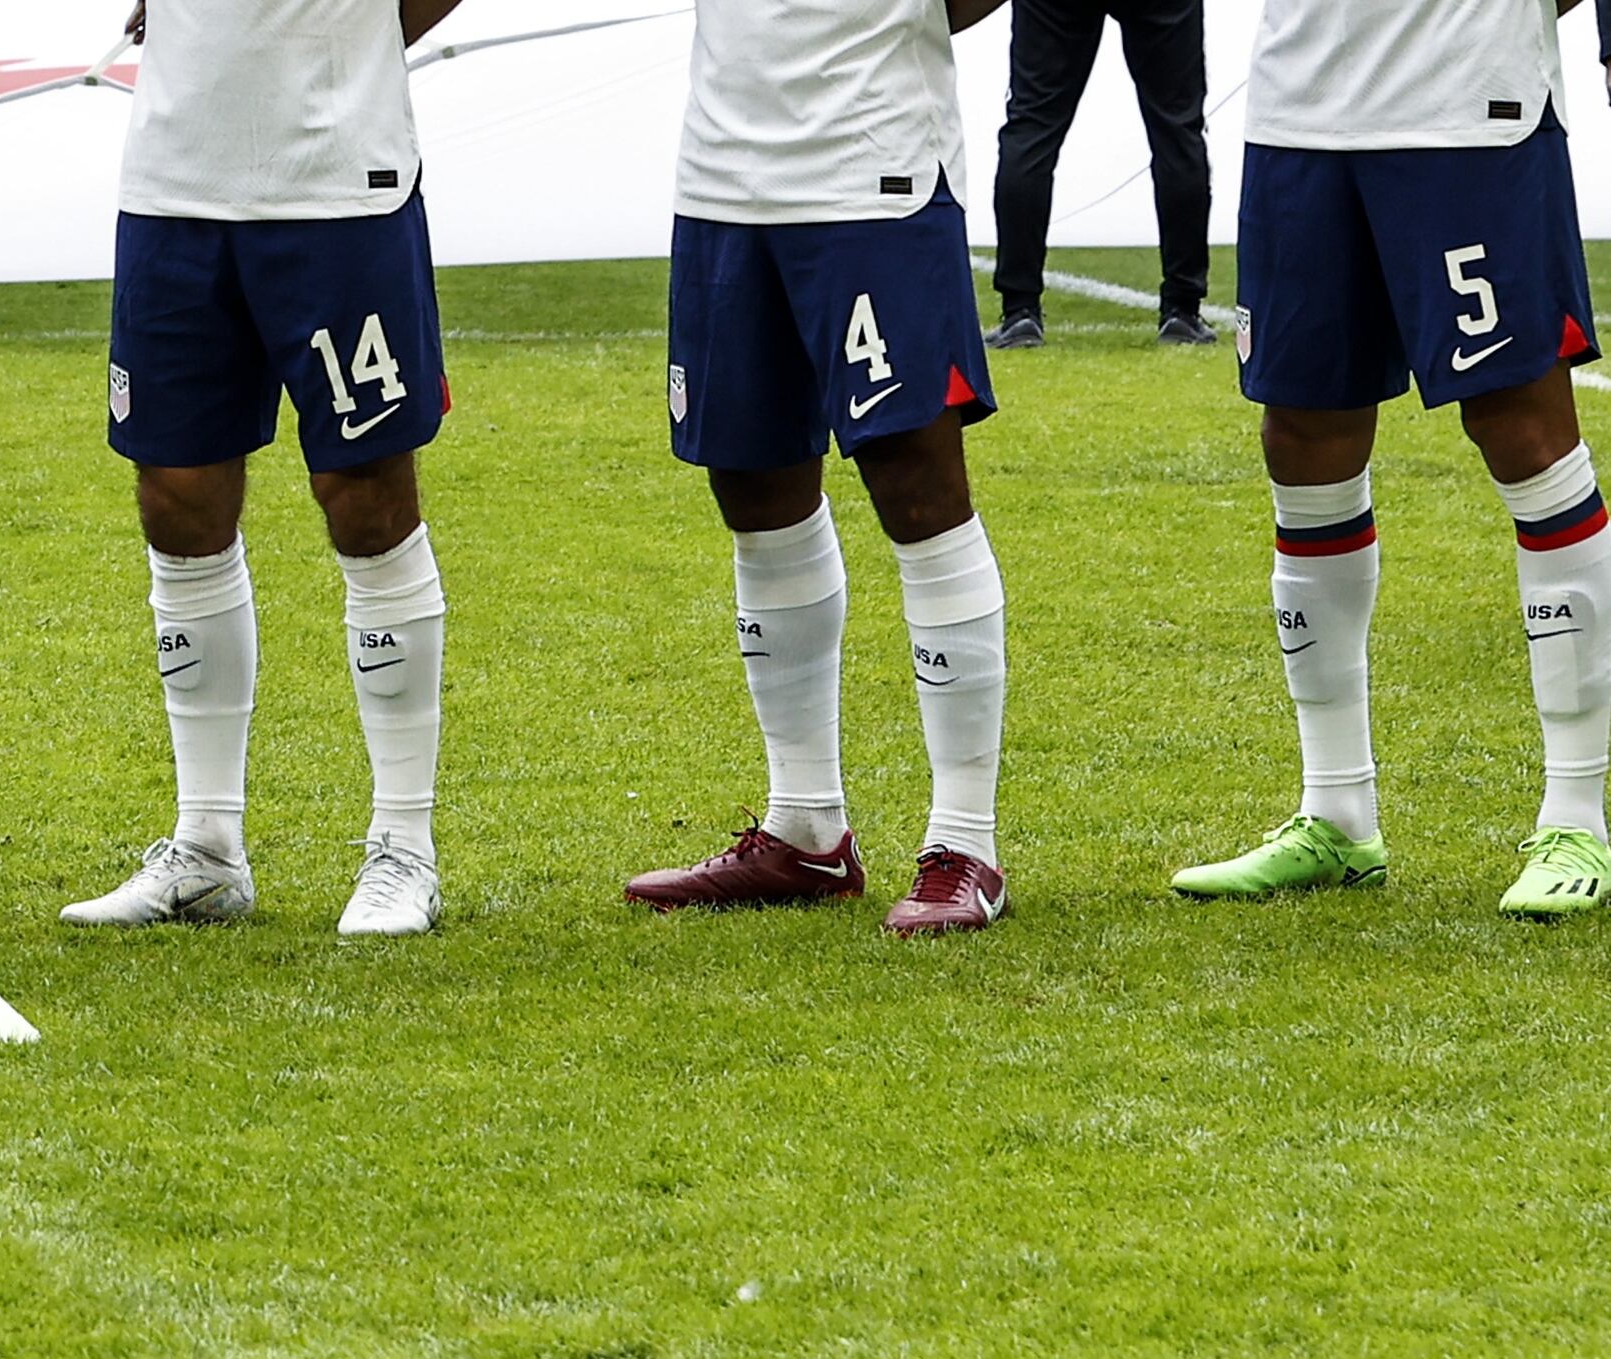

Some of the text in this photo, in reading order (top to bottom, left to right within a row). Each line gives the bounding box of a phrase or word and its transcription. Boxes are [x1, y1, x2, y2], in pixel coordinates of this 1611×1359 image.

[1444, 243, 1499, 336] 5
[310, 313, 407, 413] 14
[844, 292, 893, 383] 4
[737, 618, 763, 638] SA
[1527, 604, 1578, 620] USA
[359, 632, 397, 649] USA
